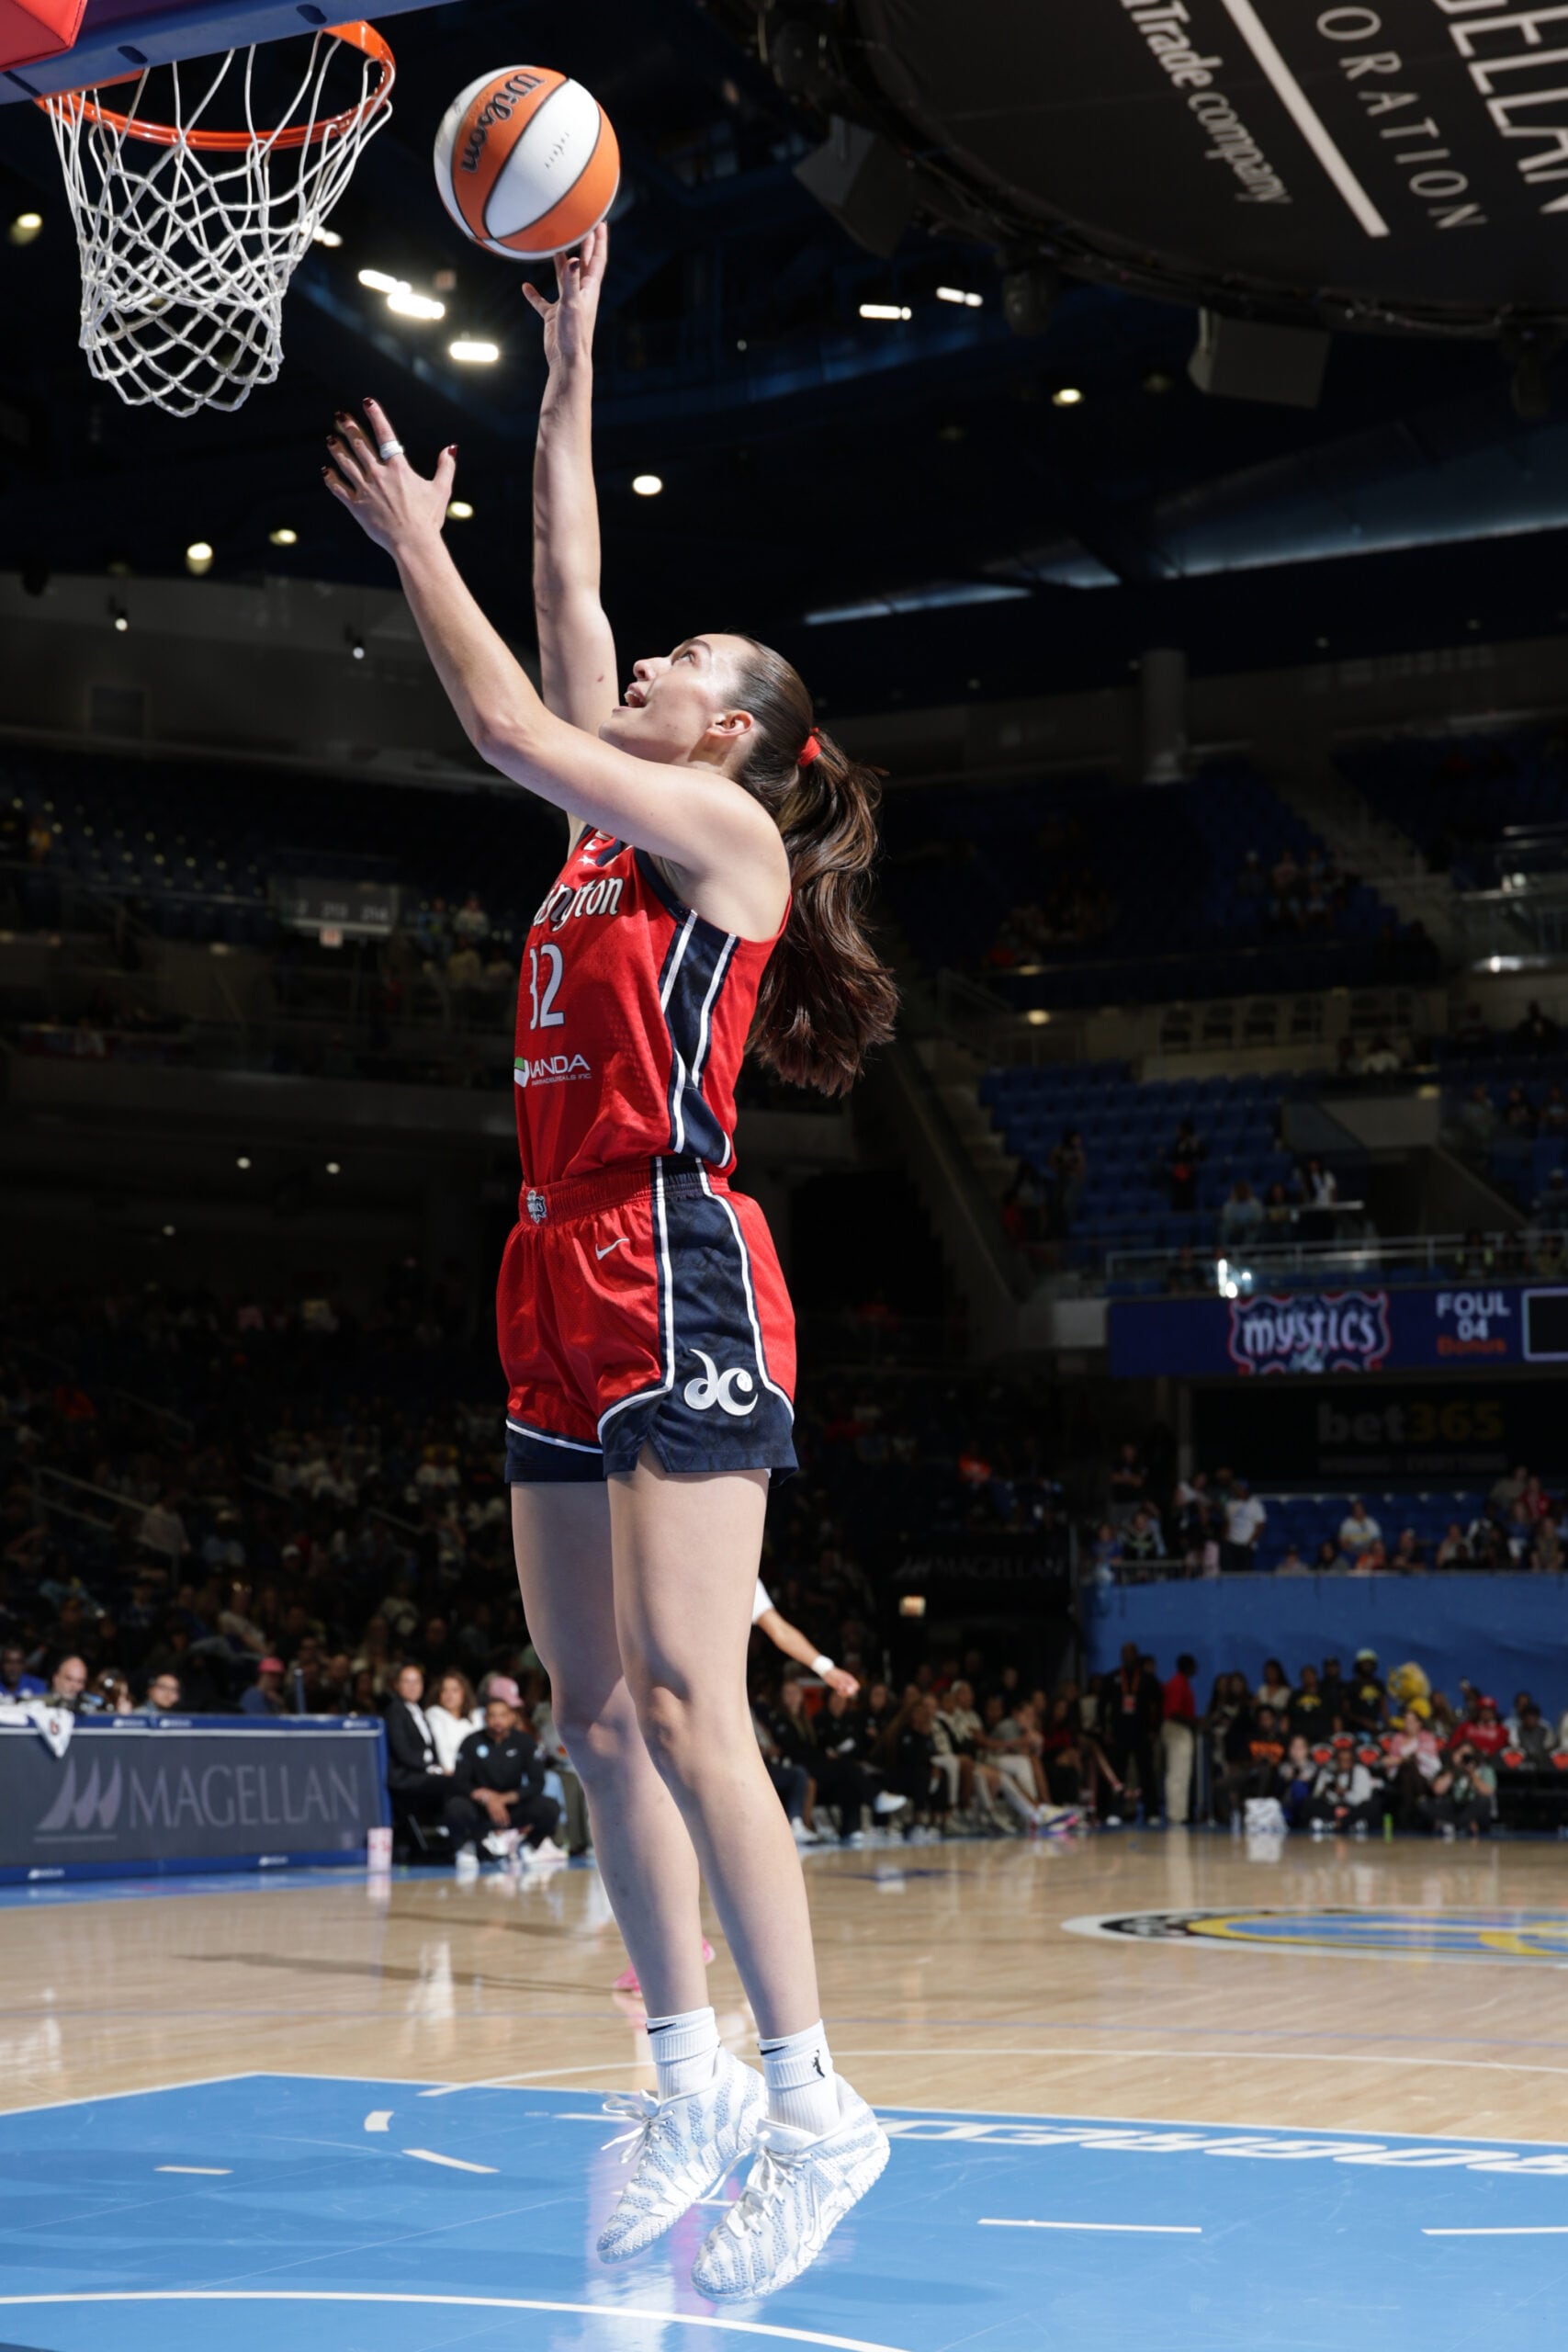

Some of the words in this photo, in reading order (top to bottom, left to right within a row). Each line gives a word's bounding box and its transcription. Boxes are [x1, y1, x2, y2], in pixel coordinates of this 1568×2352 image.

[461, 74, 546, 173] Wilson
[1187, 92, 1292, 203] company
[1436, 1292, 1511, 1318] FOUL
[1457, 1317, 1489, 1341] 04
[1317, 1400, 1506, 1444] bet365
[129, 1763, 361, 1829] MAGELLAN
